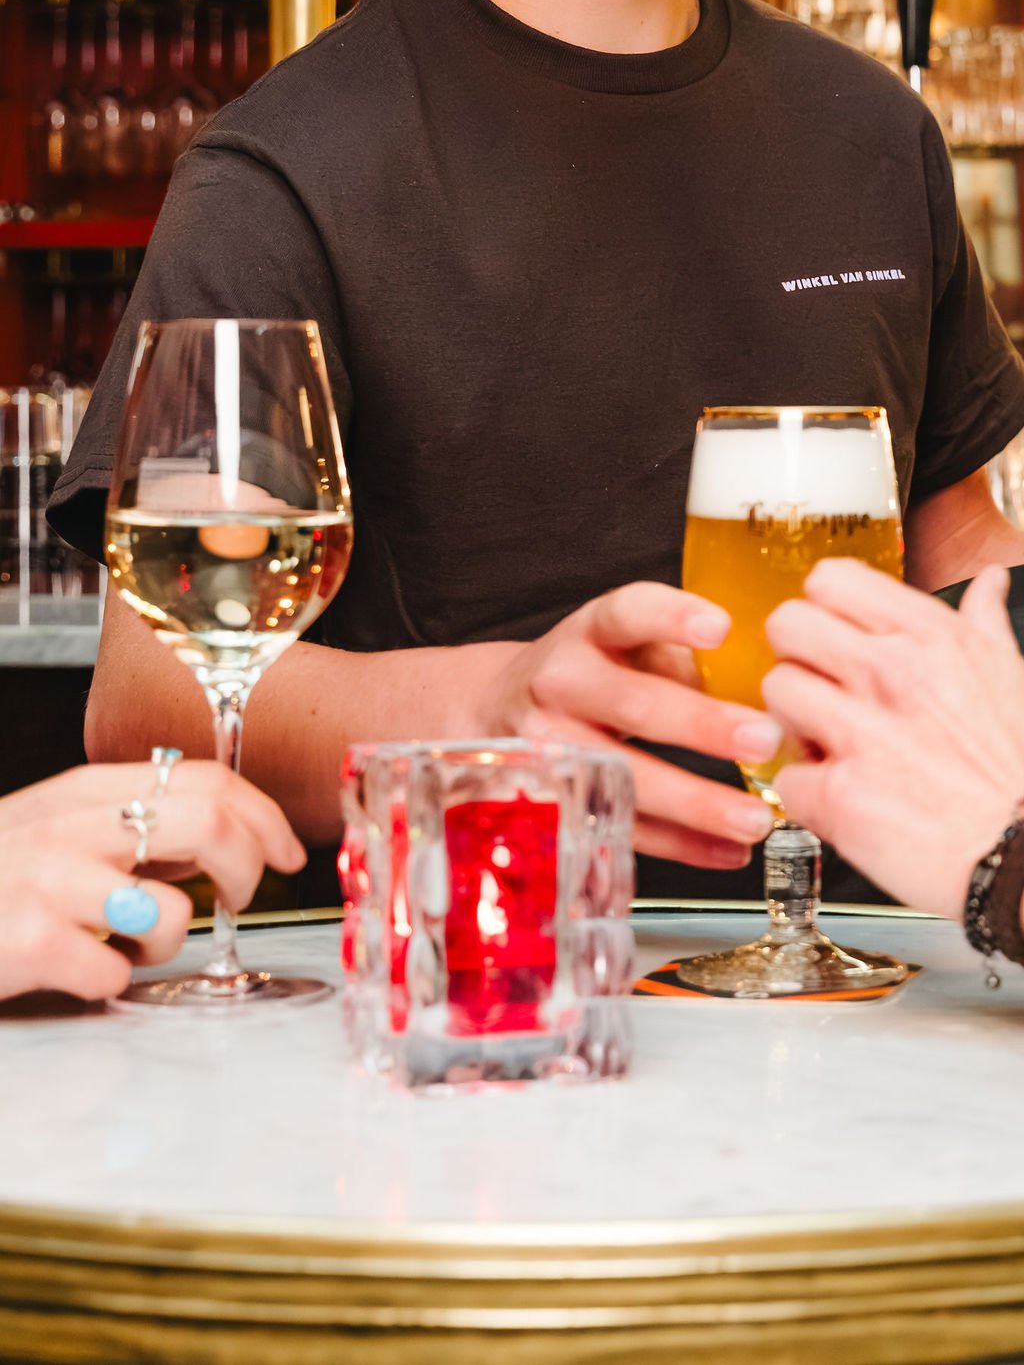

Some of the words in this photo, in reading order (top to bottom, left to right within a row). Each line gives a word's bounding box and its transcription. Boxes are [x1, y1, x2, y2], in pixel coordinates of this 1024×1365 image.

[781, 274, 839, 292] WINKEL
[839, 270, 864, 284] VAN
[865, 268, 906, 282] SINKEL
